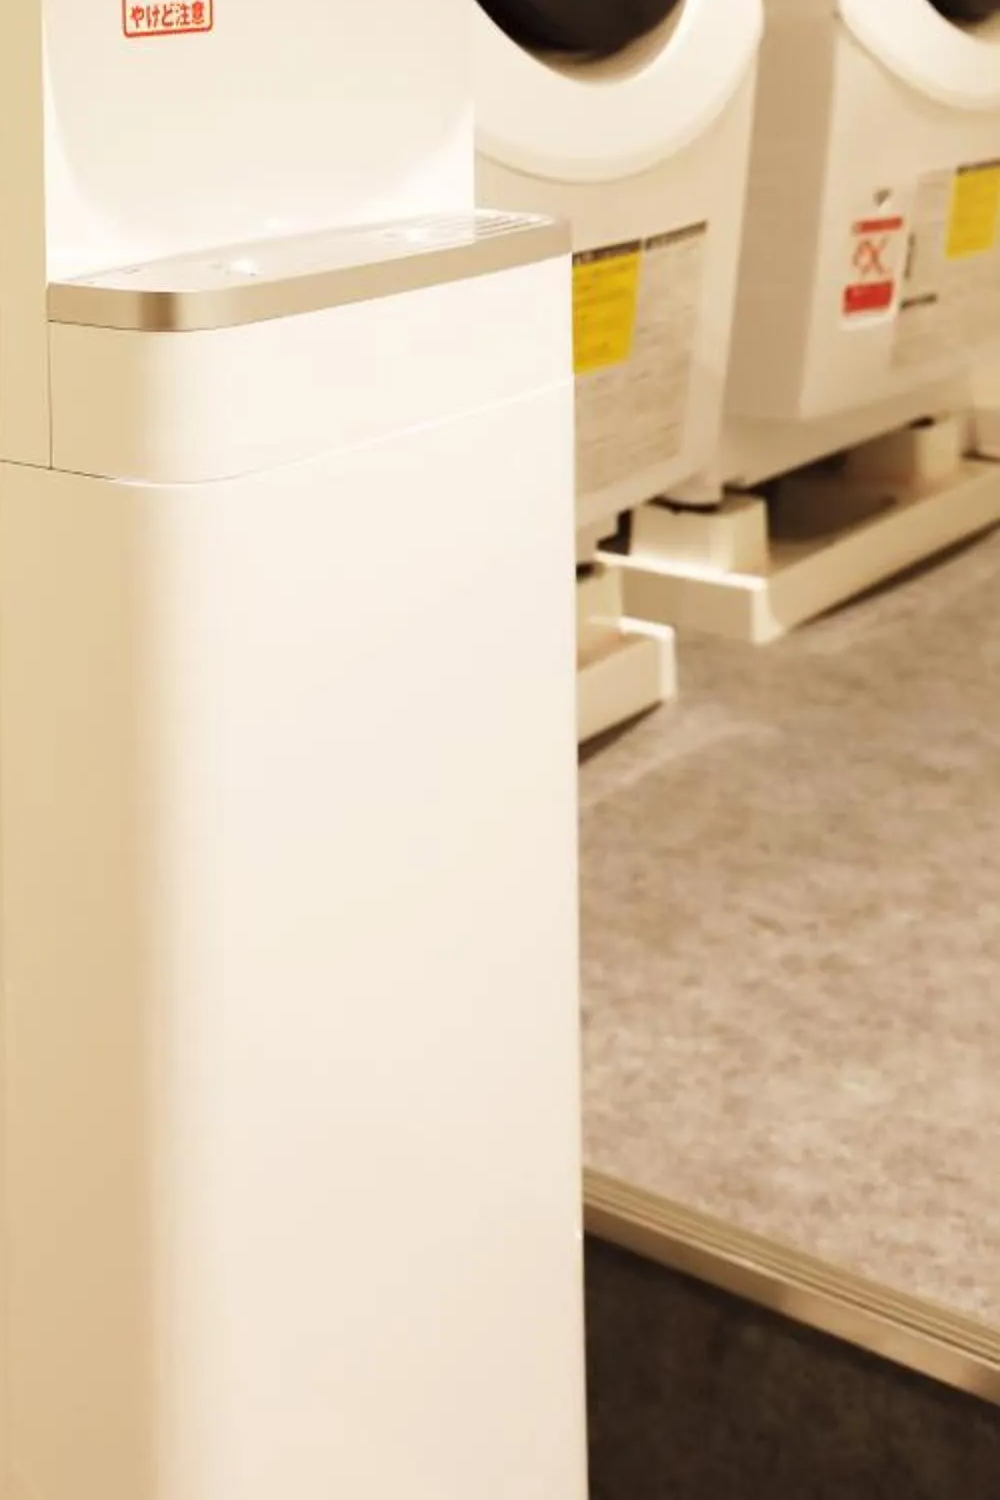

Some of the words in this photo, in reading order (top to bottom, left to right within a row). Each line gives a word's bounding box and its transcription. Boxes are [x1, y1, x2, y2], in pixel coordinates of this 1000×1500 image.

[130, 1, 205, 29] やけど注意
